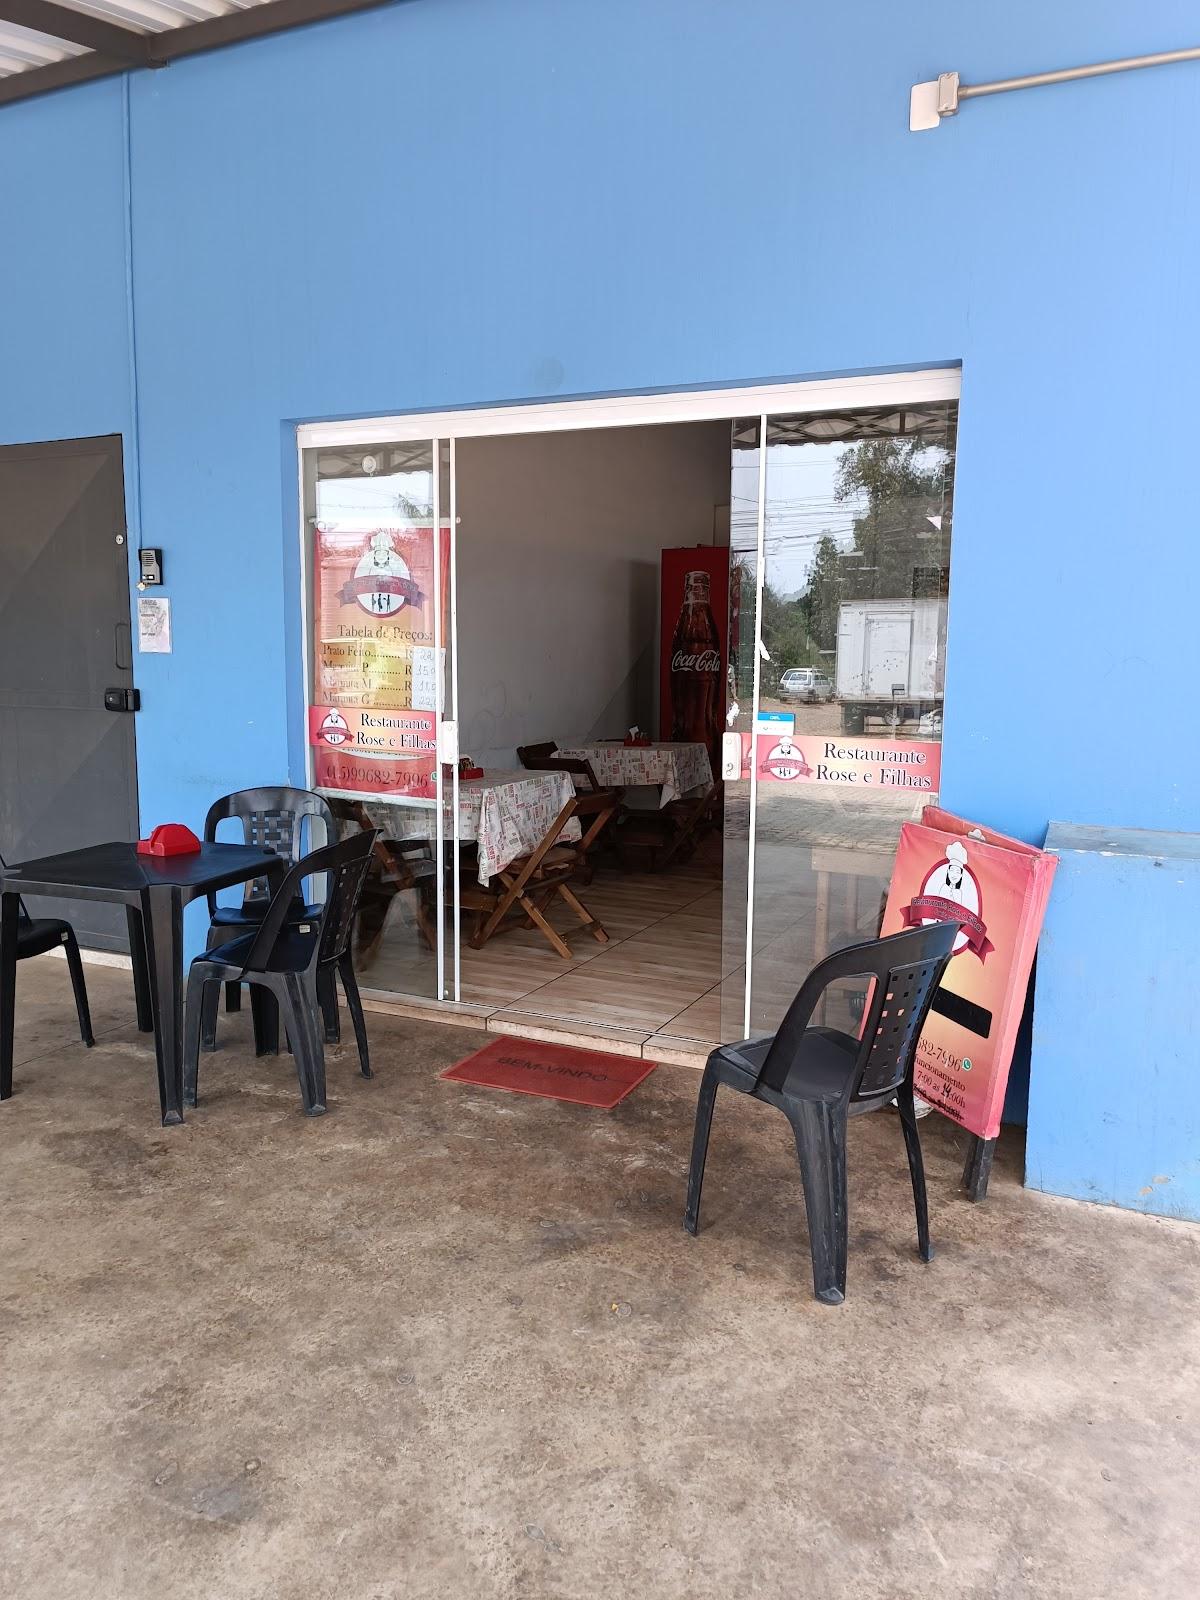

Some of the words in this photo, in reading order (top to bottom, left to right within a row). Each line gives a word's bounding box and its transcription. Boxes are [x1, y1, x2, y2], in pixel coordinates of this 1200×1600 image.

[337, 625, 372, 638] Tabela
[323, 643, 345, 656] Prato
[672, 650, 720, 671] Coca-Cola
[361, 713, 431, 730] Restaurante
[357, 731, 385, 746] Rose
[401, 734, 435, 749] Filhas
[824, 742, 926, 764] Restaurante
[816, 764, 857, 782] Rose
[863, 772, 872, 783] e
[880, 768, 932, 787] Filhas
[496, 1056, 608, 1082] BEM-VINDO
[916, 1056, 966, 1091] uncionamento
